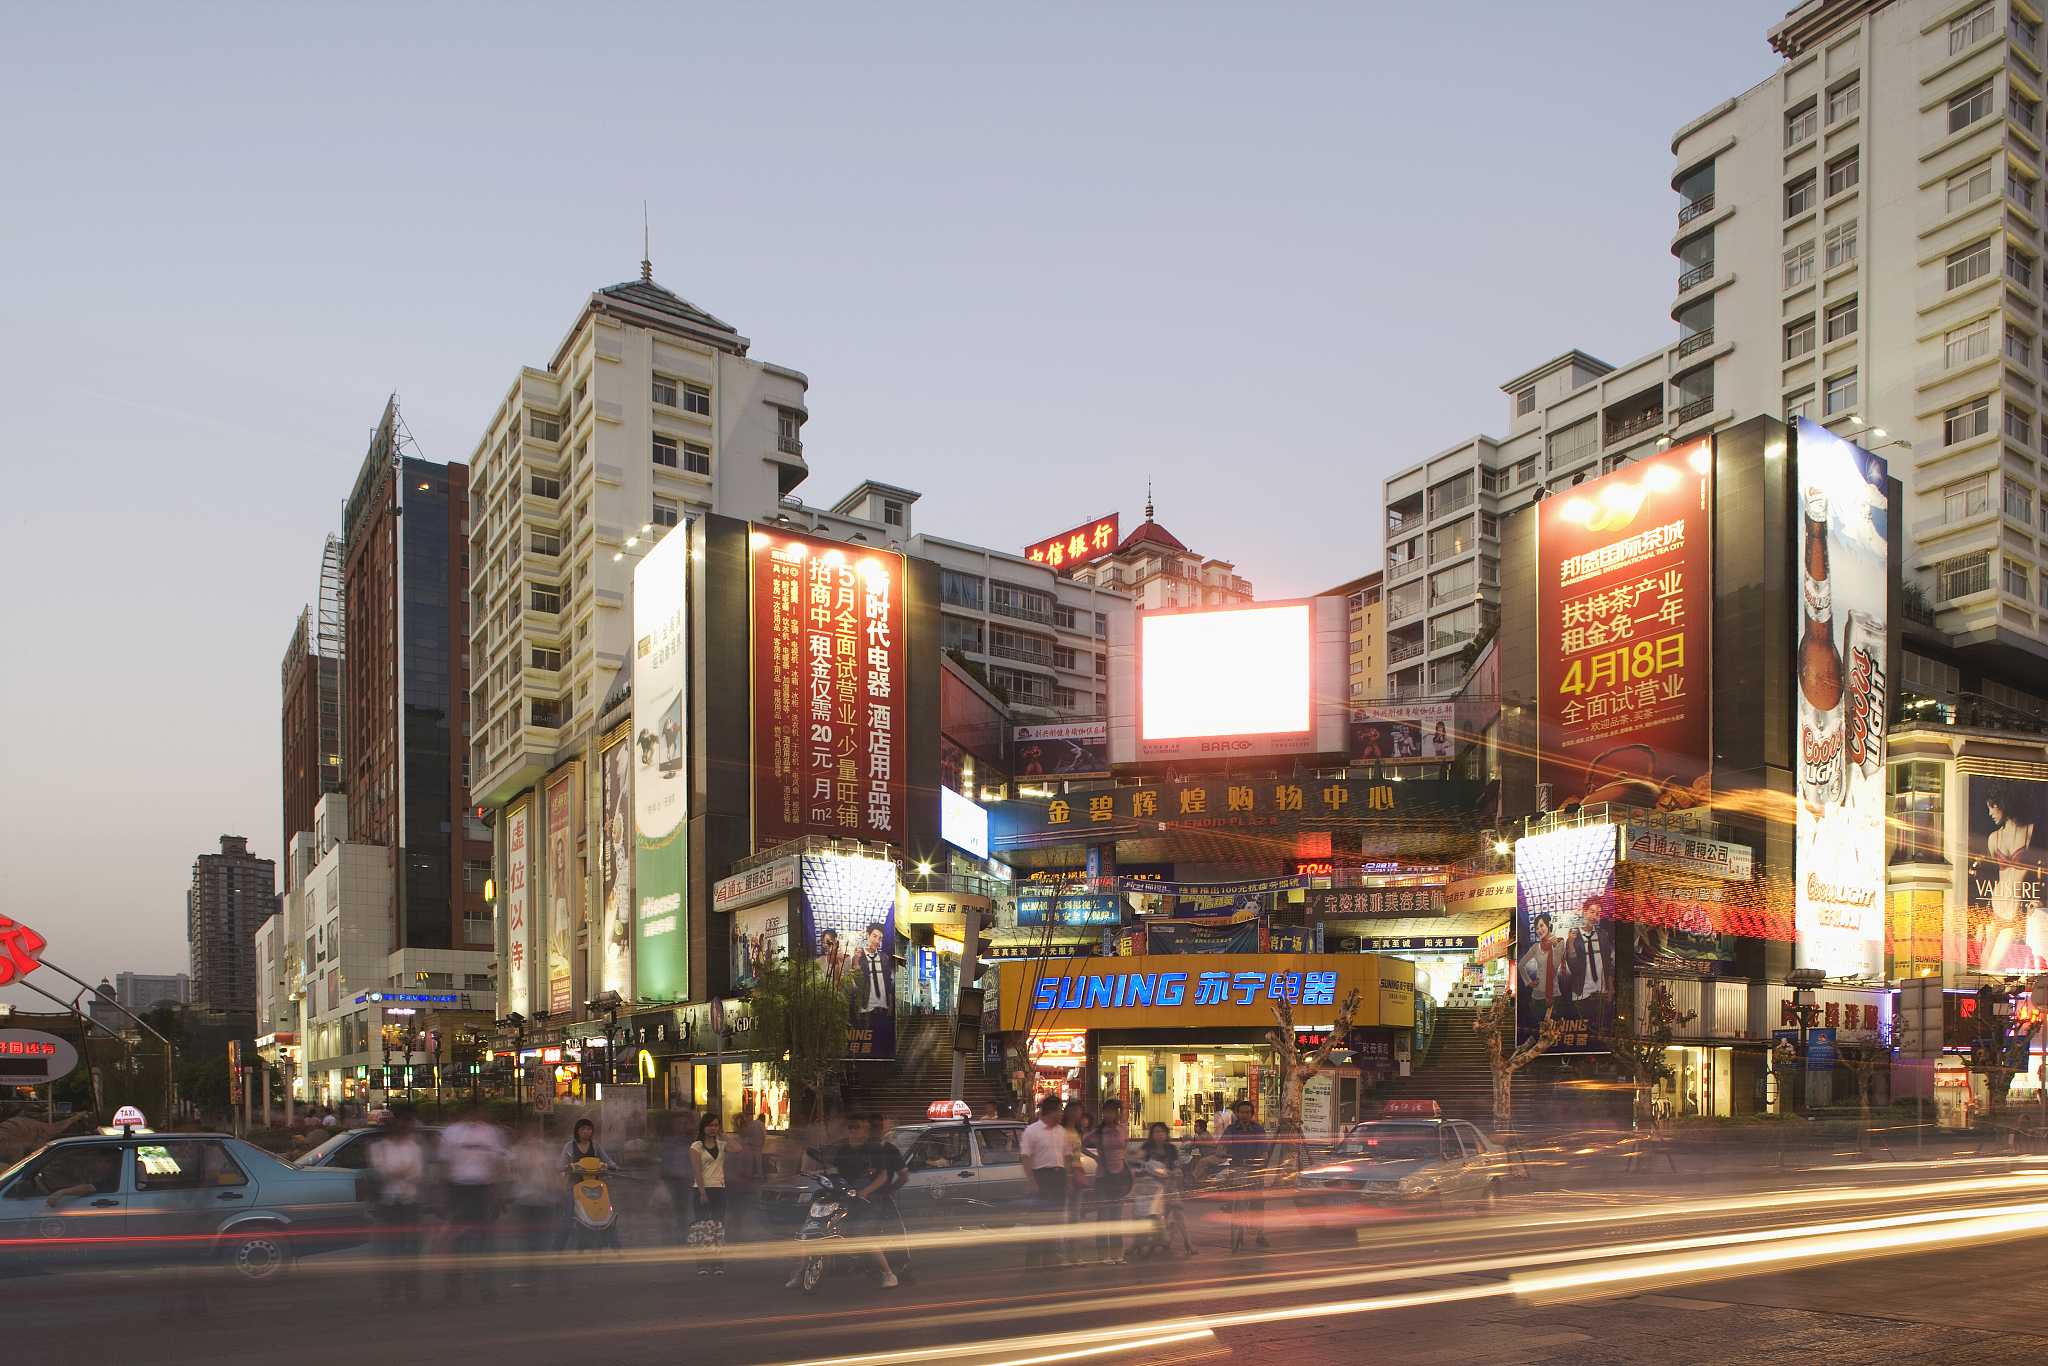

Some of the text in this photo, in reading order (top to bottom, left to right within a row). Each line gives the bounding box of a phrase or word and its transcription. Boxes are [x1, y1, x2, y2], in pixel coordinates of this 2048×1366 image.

[1029, 523, 1113, 568] 中信银行
[1561, 519, 1685, 581] 邦盛国际茶城
[1603, 553, 1656, 574] INTERNATIONAL
[1656, 547, 1669, 560] TEA
[1669, 541, 1685, 555] CITY
[808, 556, 833, 630] 招商中
[1562, 570, 1683, 628] 扶持茶产业
[1561, 599, 1685, 655] 租金免一年
[1559, 632, 1685, 696] 4月18日
[866, 570, 892, 831] 新时代电器 酒店用品城
[1561, 674, 1686, 726] 全面试营业
[1845, 646, 1873, 767] Coors
[1866, 660, 1887, 767] LIGHT
[1201, 740, 1251, 752] BARCO
[1802, 724, 1843, 765] Coors
[1806, 754, 1843, 785] LIGHT
[1047, 784, 1395, 825] 金碧辉煌购物中心
[1229, 816, 1279, 829] PLAZA
[1630, 829, 1730, 862] 直通车 眼镜公司
[509, 818, 526, 973] 虚位以待
[716, 880, 744, 904] 直通车
[1836, 886, 1876, 907] LIGHT
[1975, 879, 2041, 900] VALISERE
[1371, 937, 1464, 949] 至真至诚 阳光服务
[1034, 972, 1188, 1011] SUNING
[1194, 970, 1339, 1007] 苏宁电器
[120, 1109, 135, 1117] TAXI
